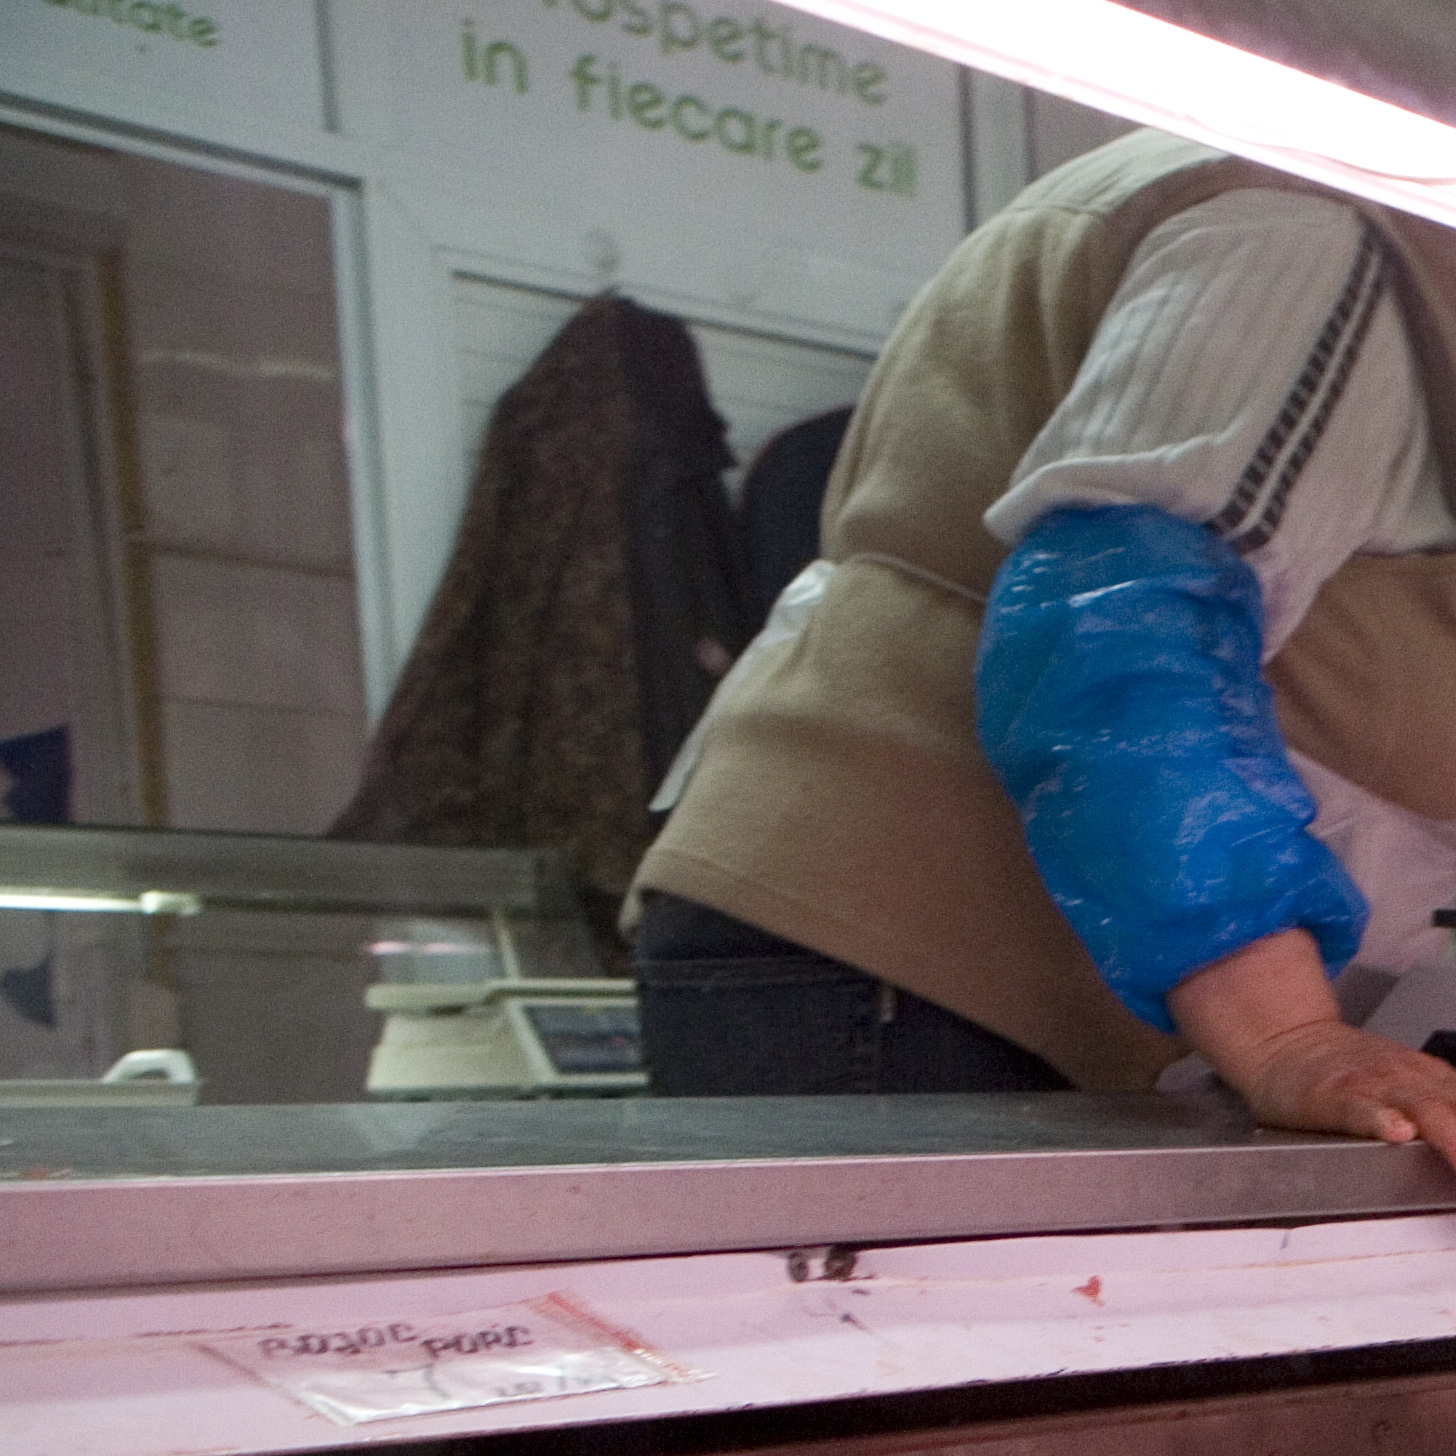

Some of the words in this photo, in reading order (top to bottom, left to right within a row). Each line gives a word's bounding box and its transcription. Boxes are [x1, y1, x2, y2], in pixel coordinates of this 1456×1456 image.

[460, 17, 529, 95] in
[570, 54, 823, 174] fiecare
[541, 0, 888, 106] ospetime
